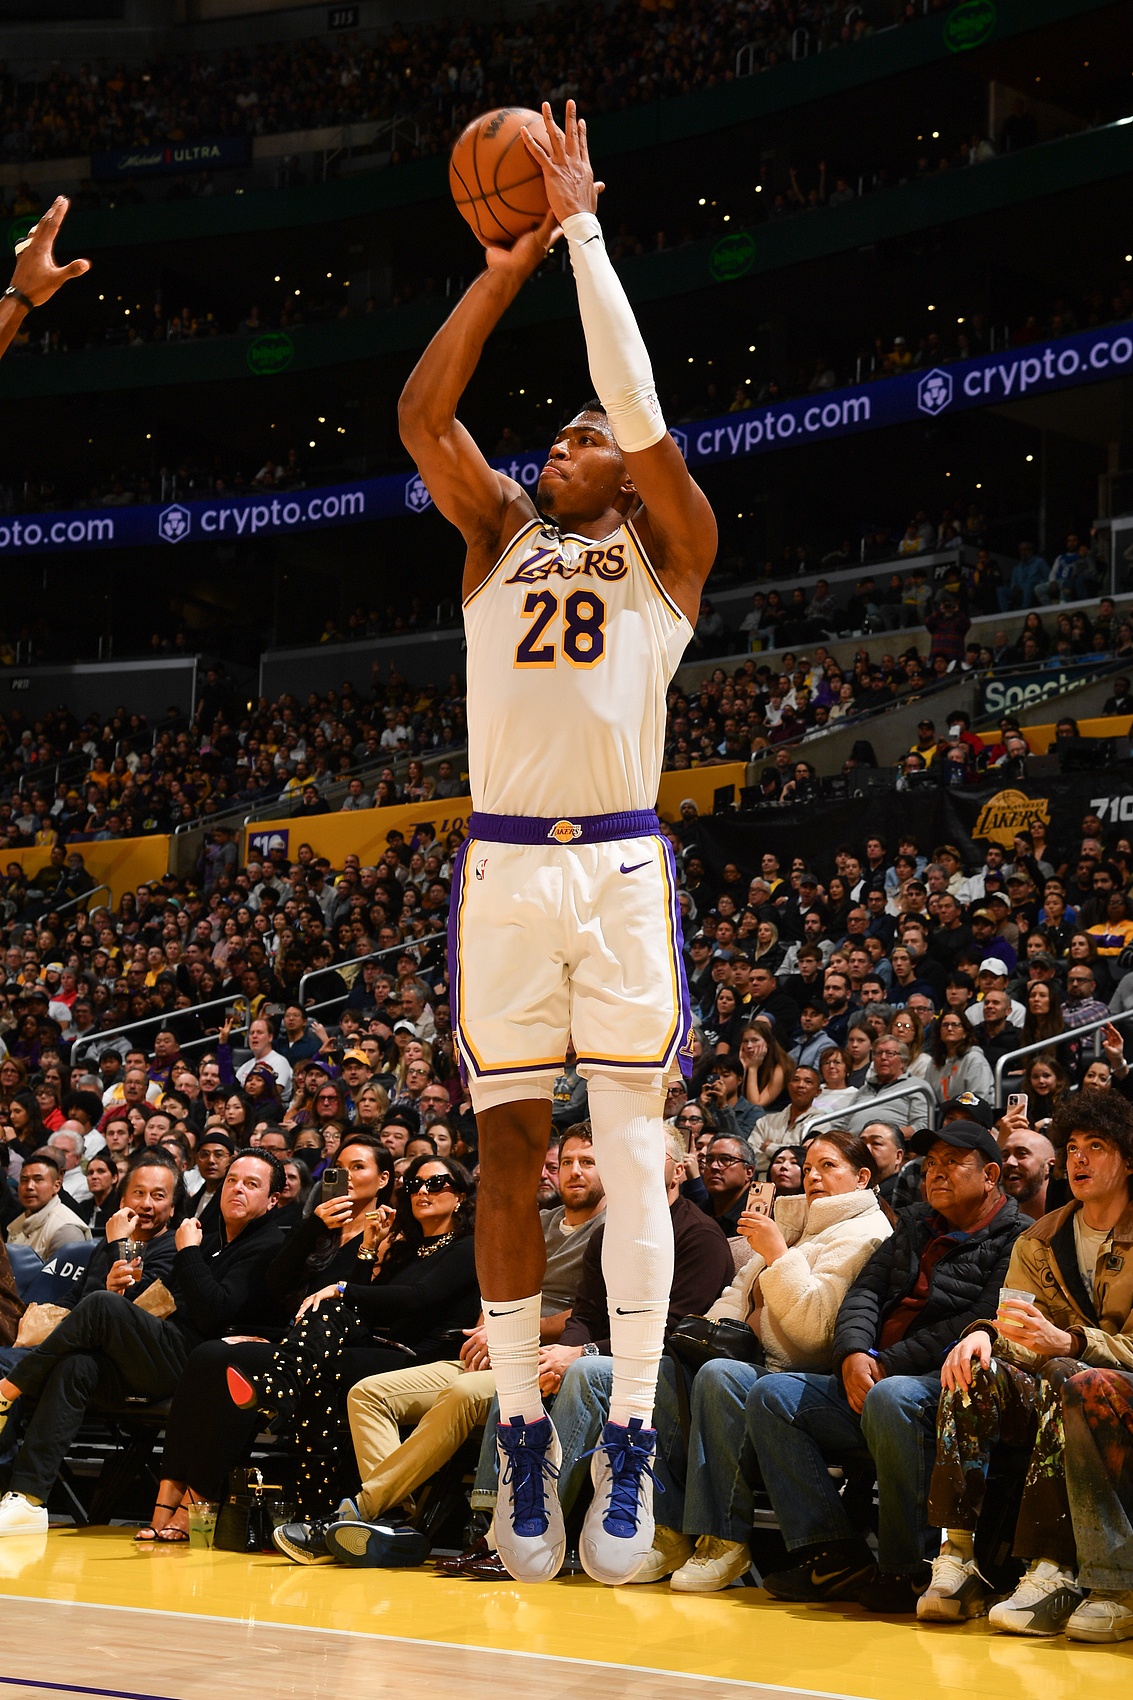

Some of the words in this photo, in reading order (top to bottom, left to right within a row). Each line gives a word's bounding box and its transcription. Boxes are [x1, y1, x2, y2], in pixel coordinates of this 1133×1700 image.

[174, 145, 220, 162] ULTRA
[697, 396, 870, 454] crypto.com
[201, 491, 365, 534] crypto.com
[513, 588, 607, 670] 28
